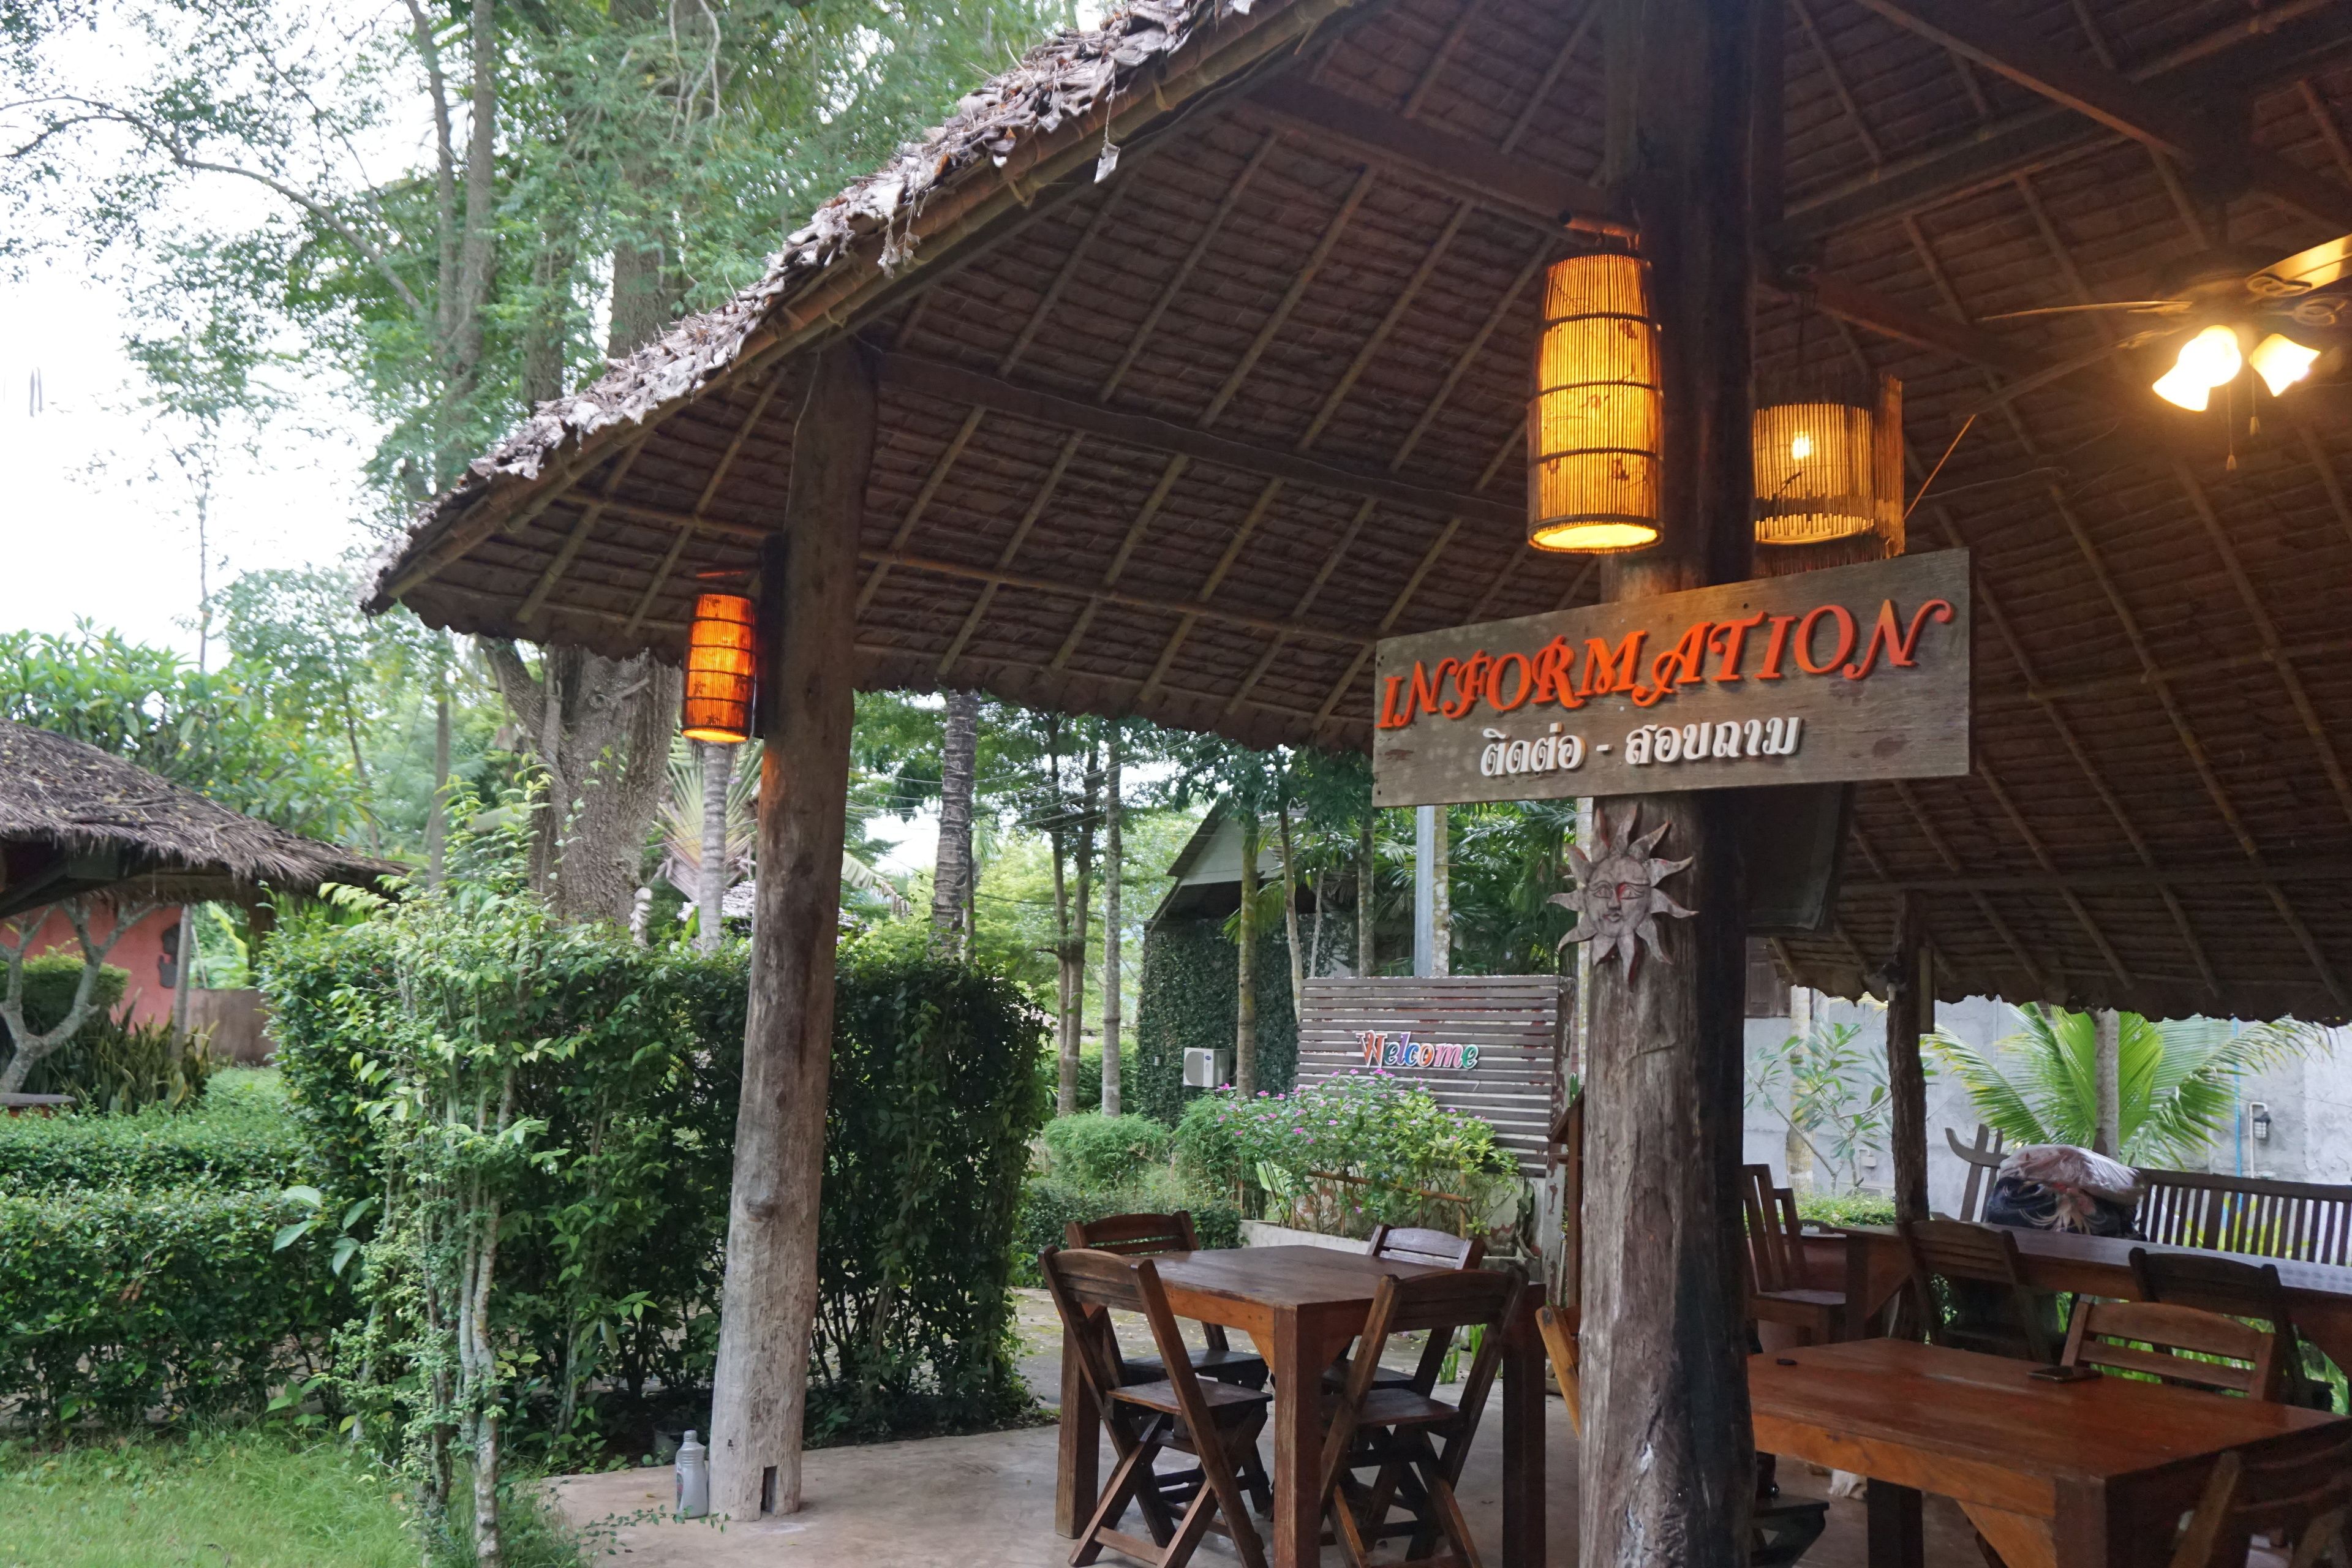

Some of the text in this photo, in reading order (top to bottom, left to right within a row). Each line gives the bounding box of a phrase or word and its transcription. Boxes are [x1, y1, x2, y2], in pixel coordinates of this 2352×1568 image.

[1375, 600, 1953, 728] INFORMATION
[1480, 723, 1585, 777] ติดต่อ
[1625, 717, 1801, 765] สอบถาม
[1356, 1030, 1479, 1069] Welcome
